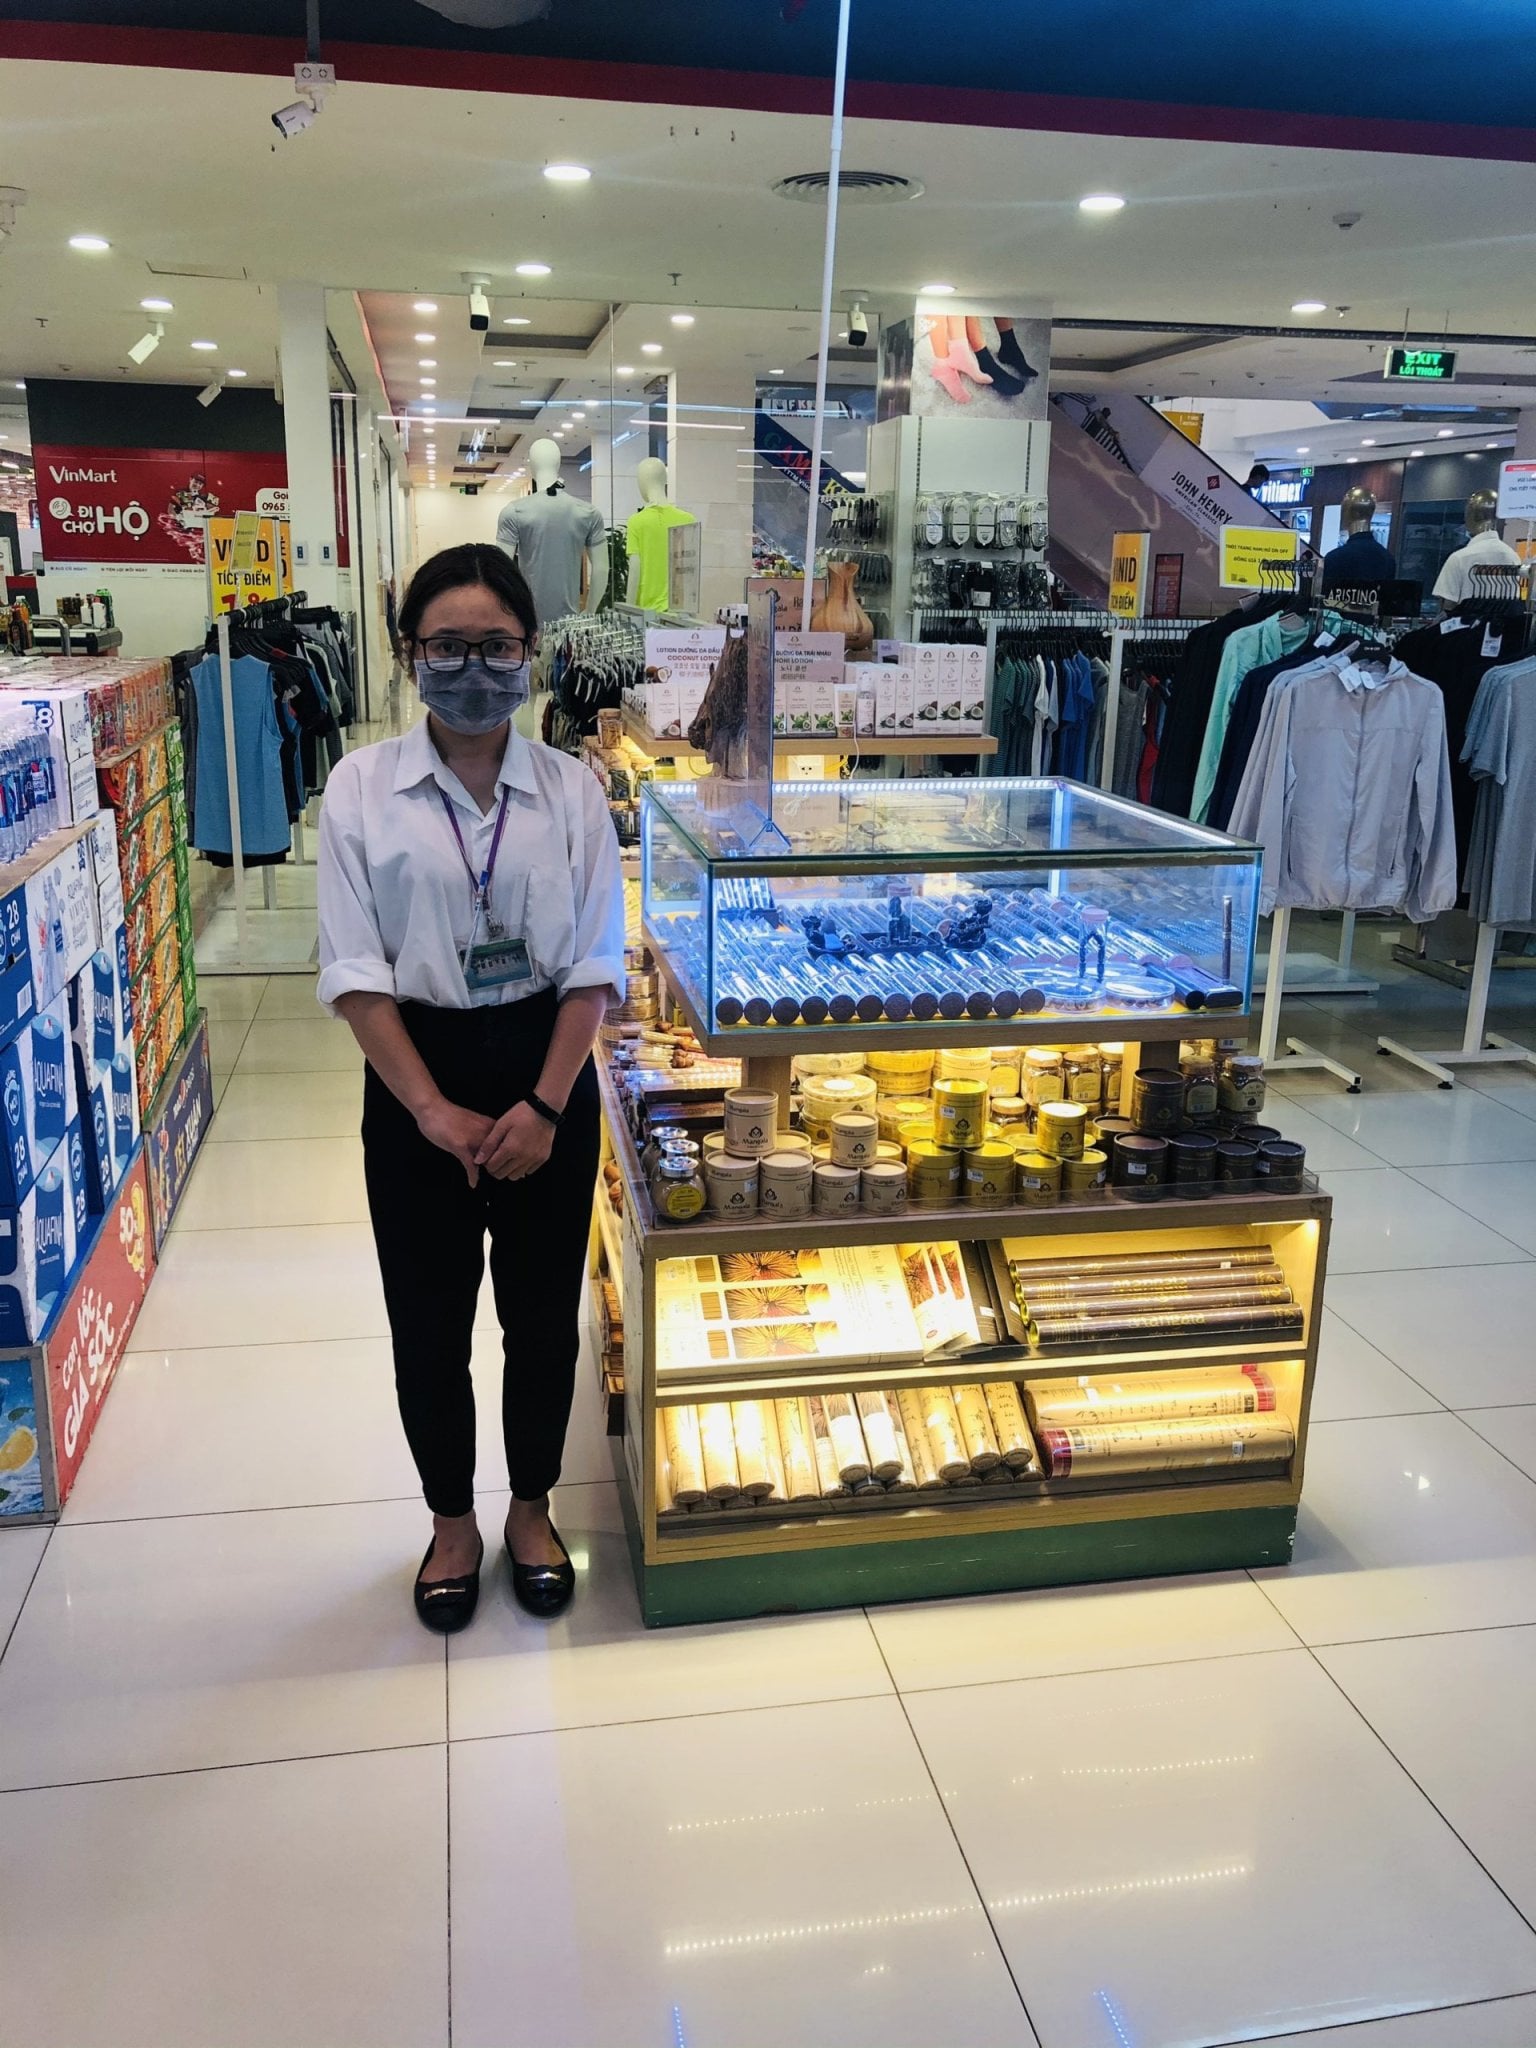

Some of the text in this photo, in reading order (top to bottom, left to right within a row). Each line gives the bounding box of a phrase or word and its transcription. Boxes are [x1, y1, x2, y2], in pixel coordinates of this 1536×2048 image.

[1404, 352, 1442, 365] EXIT
[1416, 366, 1444, 377] THOÁT
[49, 465, 117, 484] VinMart
[262, 502, 285, 511] 0965
[1171, 471, 1200, 498] JOHN
[1198, 493, 1233, 525] HENRY
[77, 505, 93, 518] ĐI
[96, 500, 149, 540] HỘ
[62, 520, 95, 536] CHỢ
[244, 569, 271, 586] ĐIỂM
[1327, 588, 1378, 604] ARISTINO
[7, 899, 19, 930] 28
[15, 1136, 25, 1169] 28
[76, 1188, 85, 1218] 28
[65, 1292, 114, 1457] GIÁ SỐC
